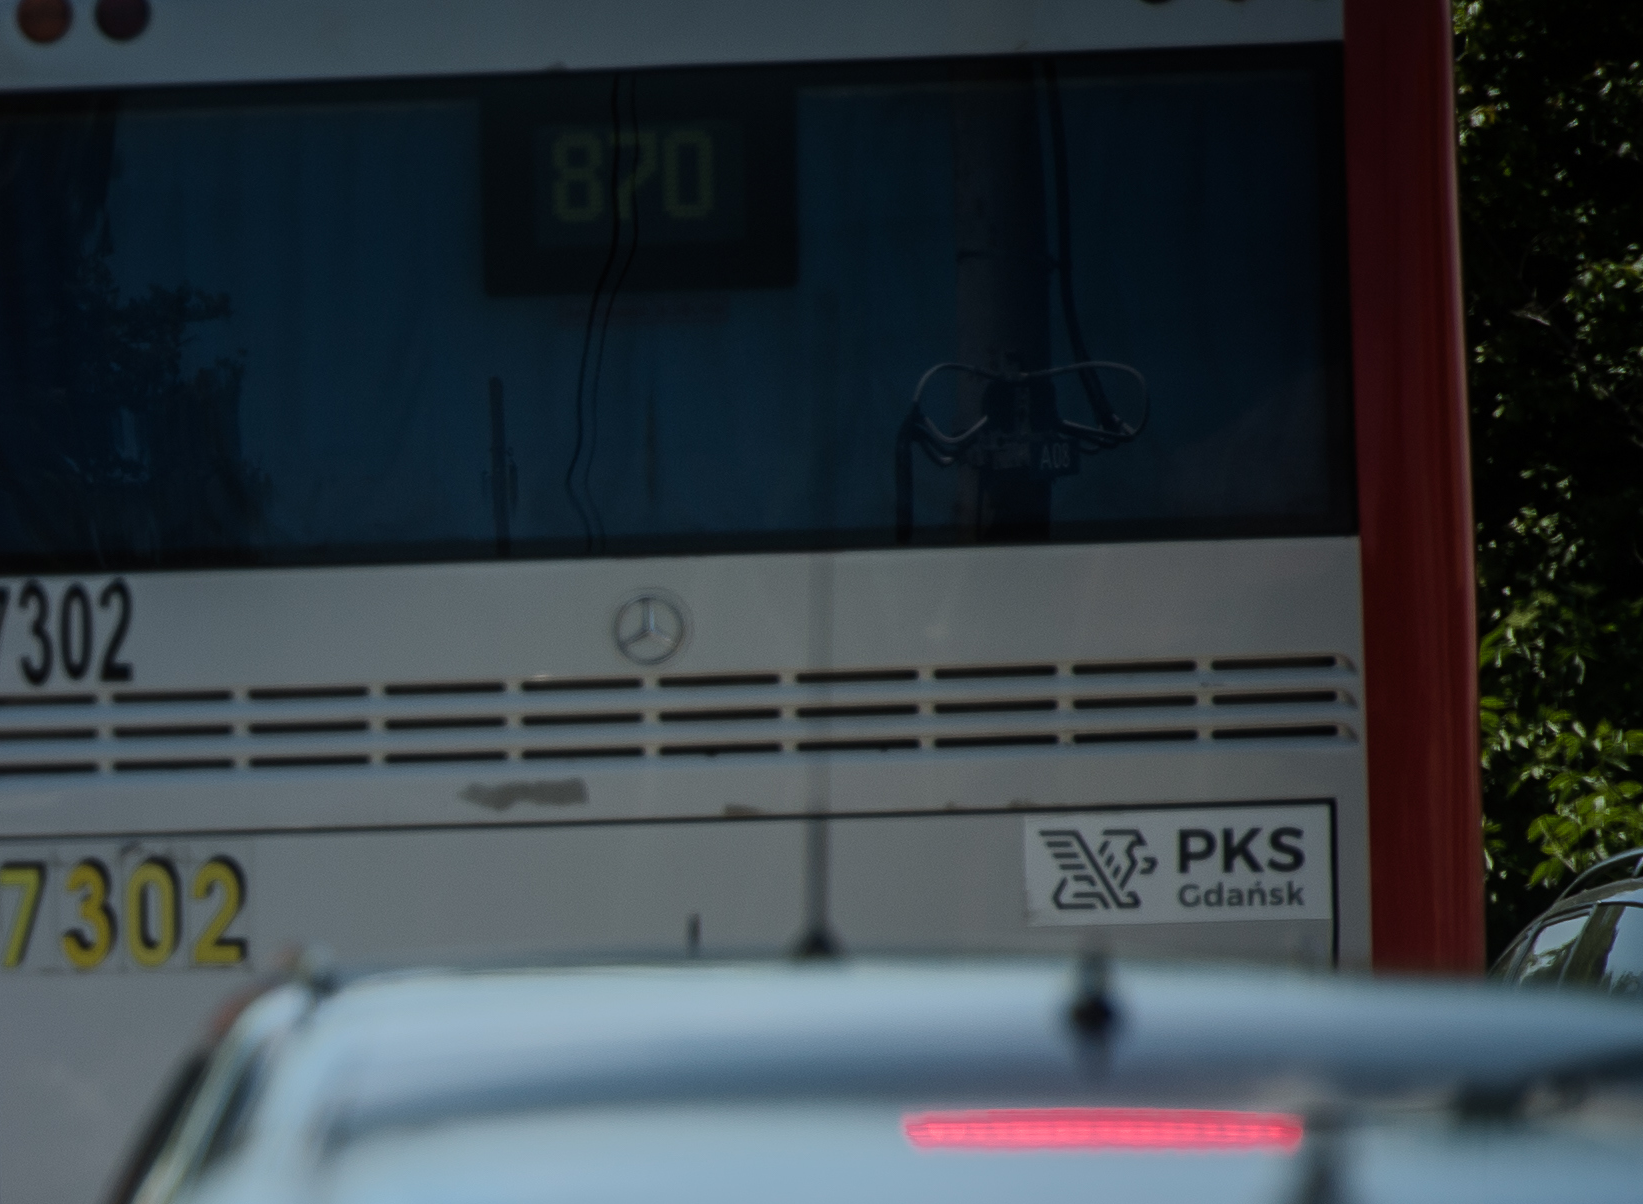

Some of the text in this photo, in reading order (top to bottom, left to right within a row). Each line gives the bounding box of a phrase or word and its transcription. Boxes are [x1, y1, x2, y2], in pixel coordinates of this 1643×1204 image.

[552, 129, 714, 221] 870
[1178, 826, 1306, 874] PKS
[1178, 881, 1305, 908] Gdańsk
